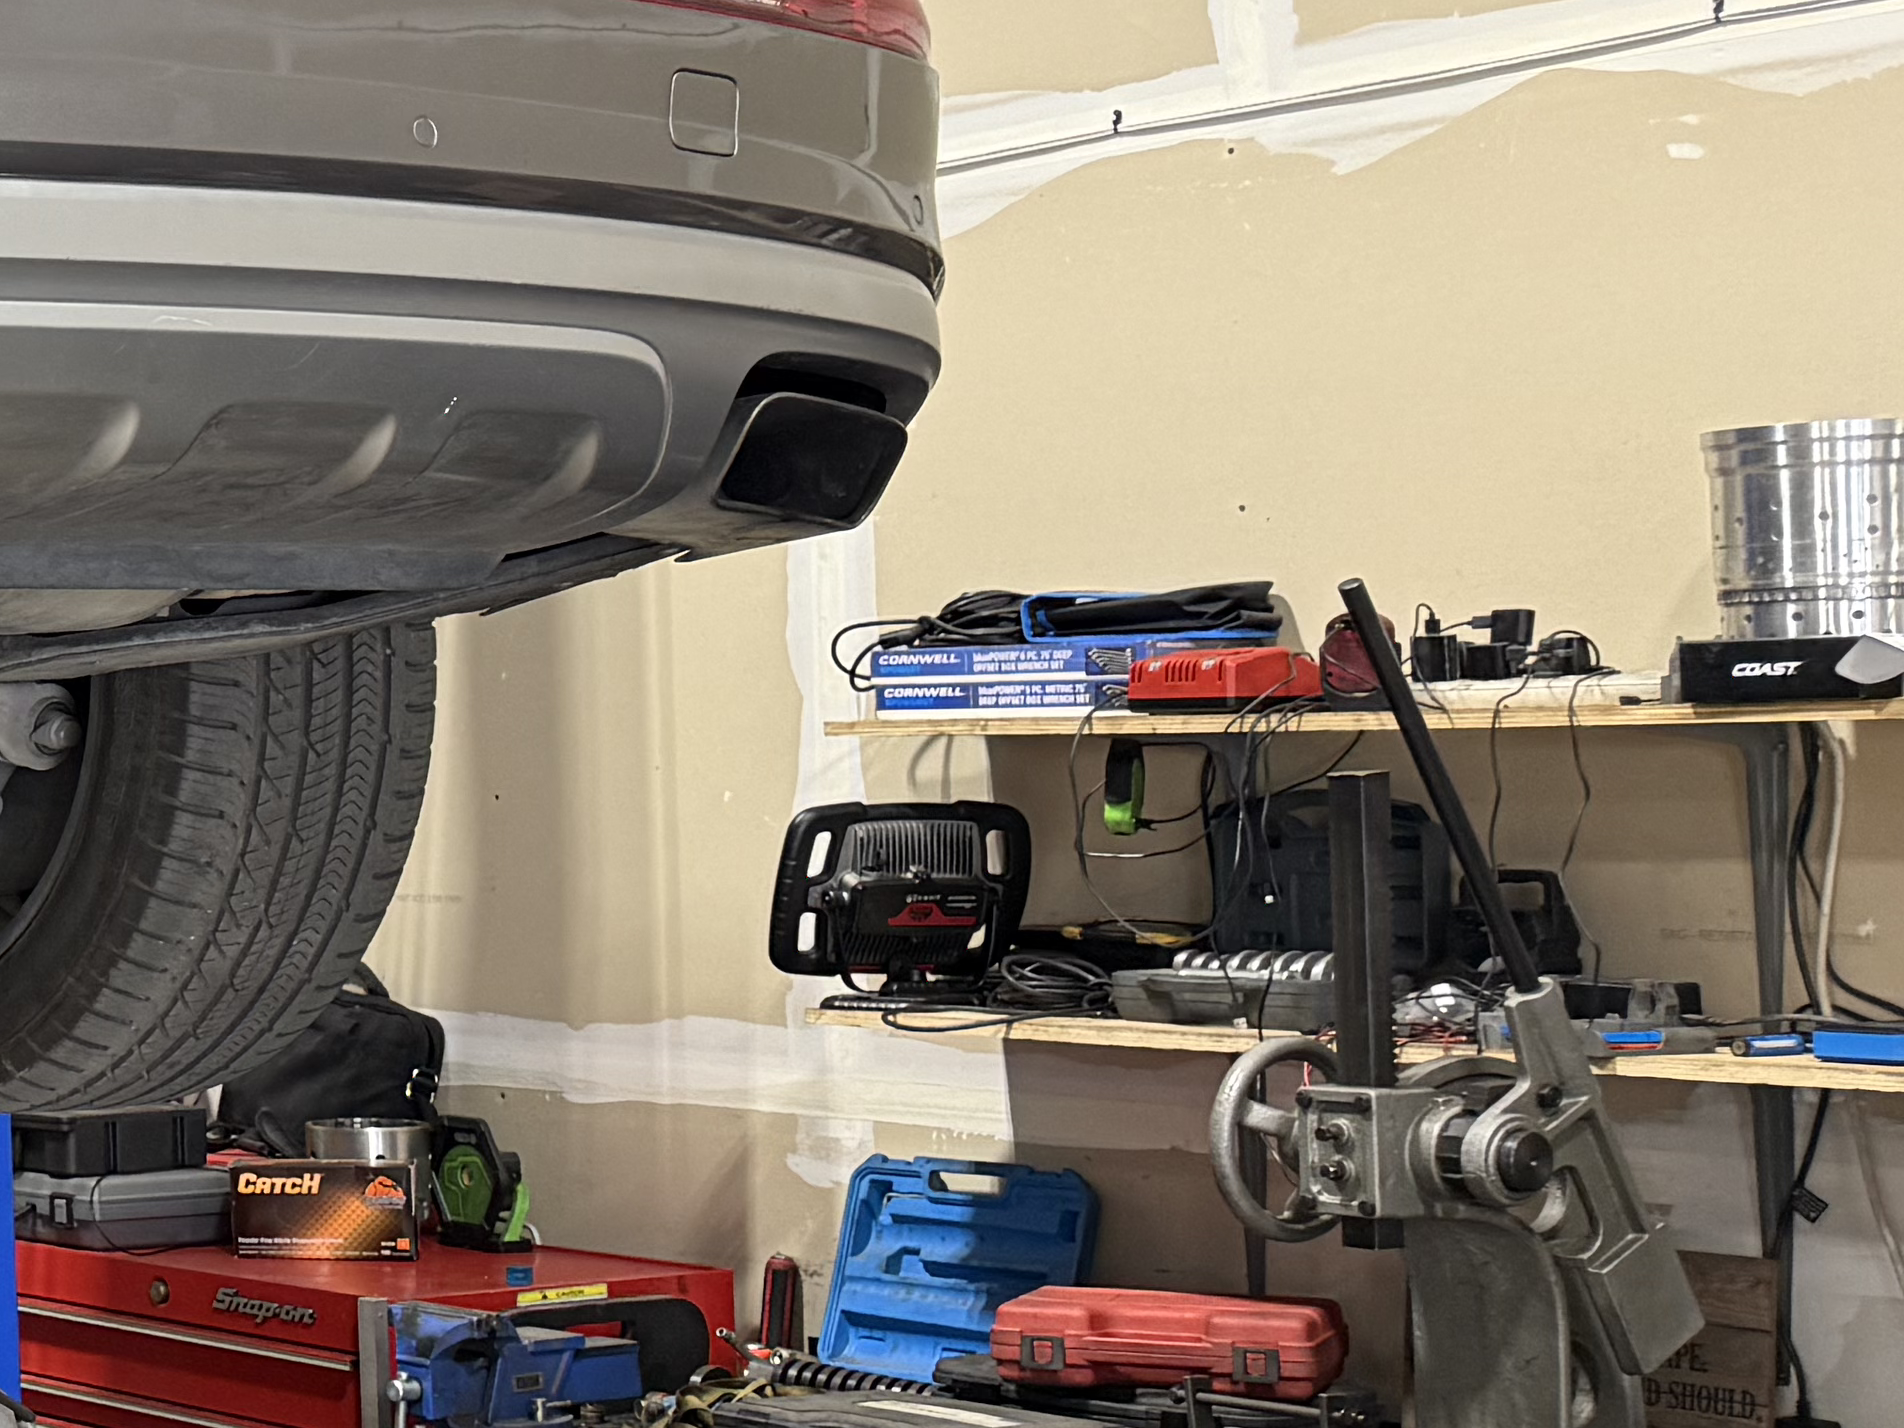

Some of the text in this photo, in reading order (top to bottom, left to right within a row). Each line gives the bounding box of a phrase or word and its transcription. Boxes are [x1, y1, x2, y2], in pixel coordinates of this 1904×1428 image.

[878, 654, 960, 665] CORNWELL
[1050, 660, 1064, 669] SET
[1732, 661, 1804, 677] COAST
[884, 687, 967, 698] CORNWELL
[238, 1172, 322, 1195] CATCH
[212, 1286, 317, 1325] Snap-on
[1667, 1380, 1763, 1424] SHOULD.
